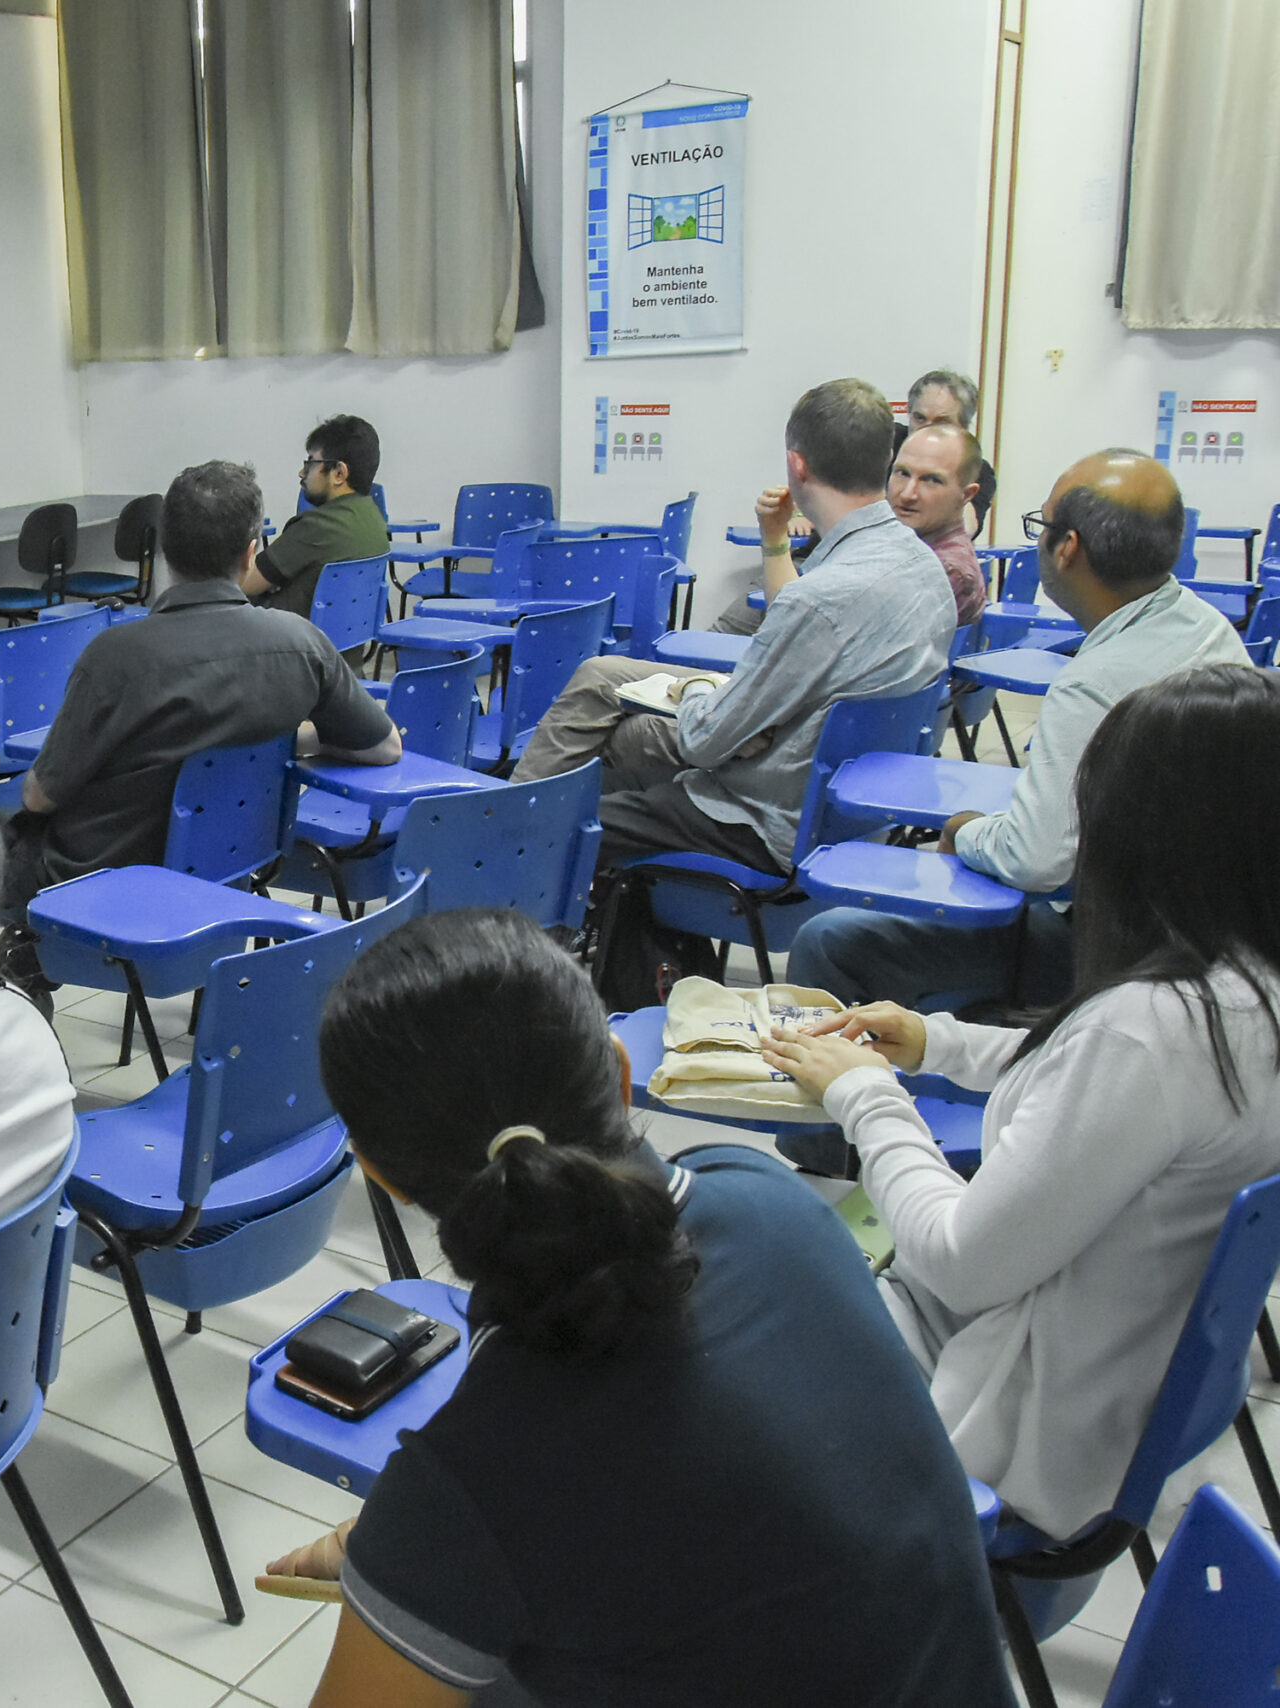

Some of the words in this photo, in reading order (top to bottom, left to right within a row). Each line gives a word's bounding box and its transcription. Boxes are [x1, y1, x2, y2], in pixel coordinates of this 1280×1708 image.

[631, 144, 724, 167] VENTILAÇÃO
[647, 264, 704, 277] Mantenha
[642, 284, 651, 293] o
[653, 280, 708, 292] ambiente
[632, 297, 657, 308] bem
[661, 294, 719, 306] ventilado.
